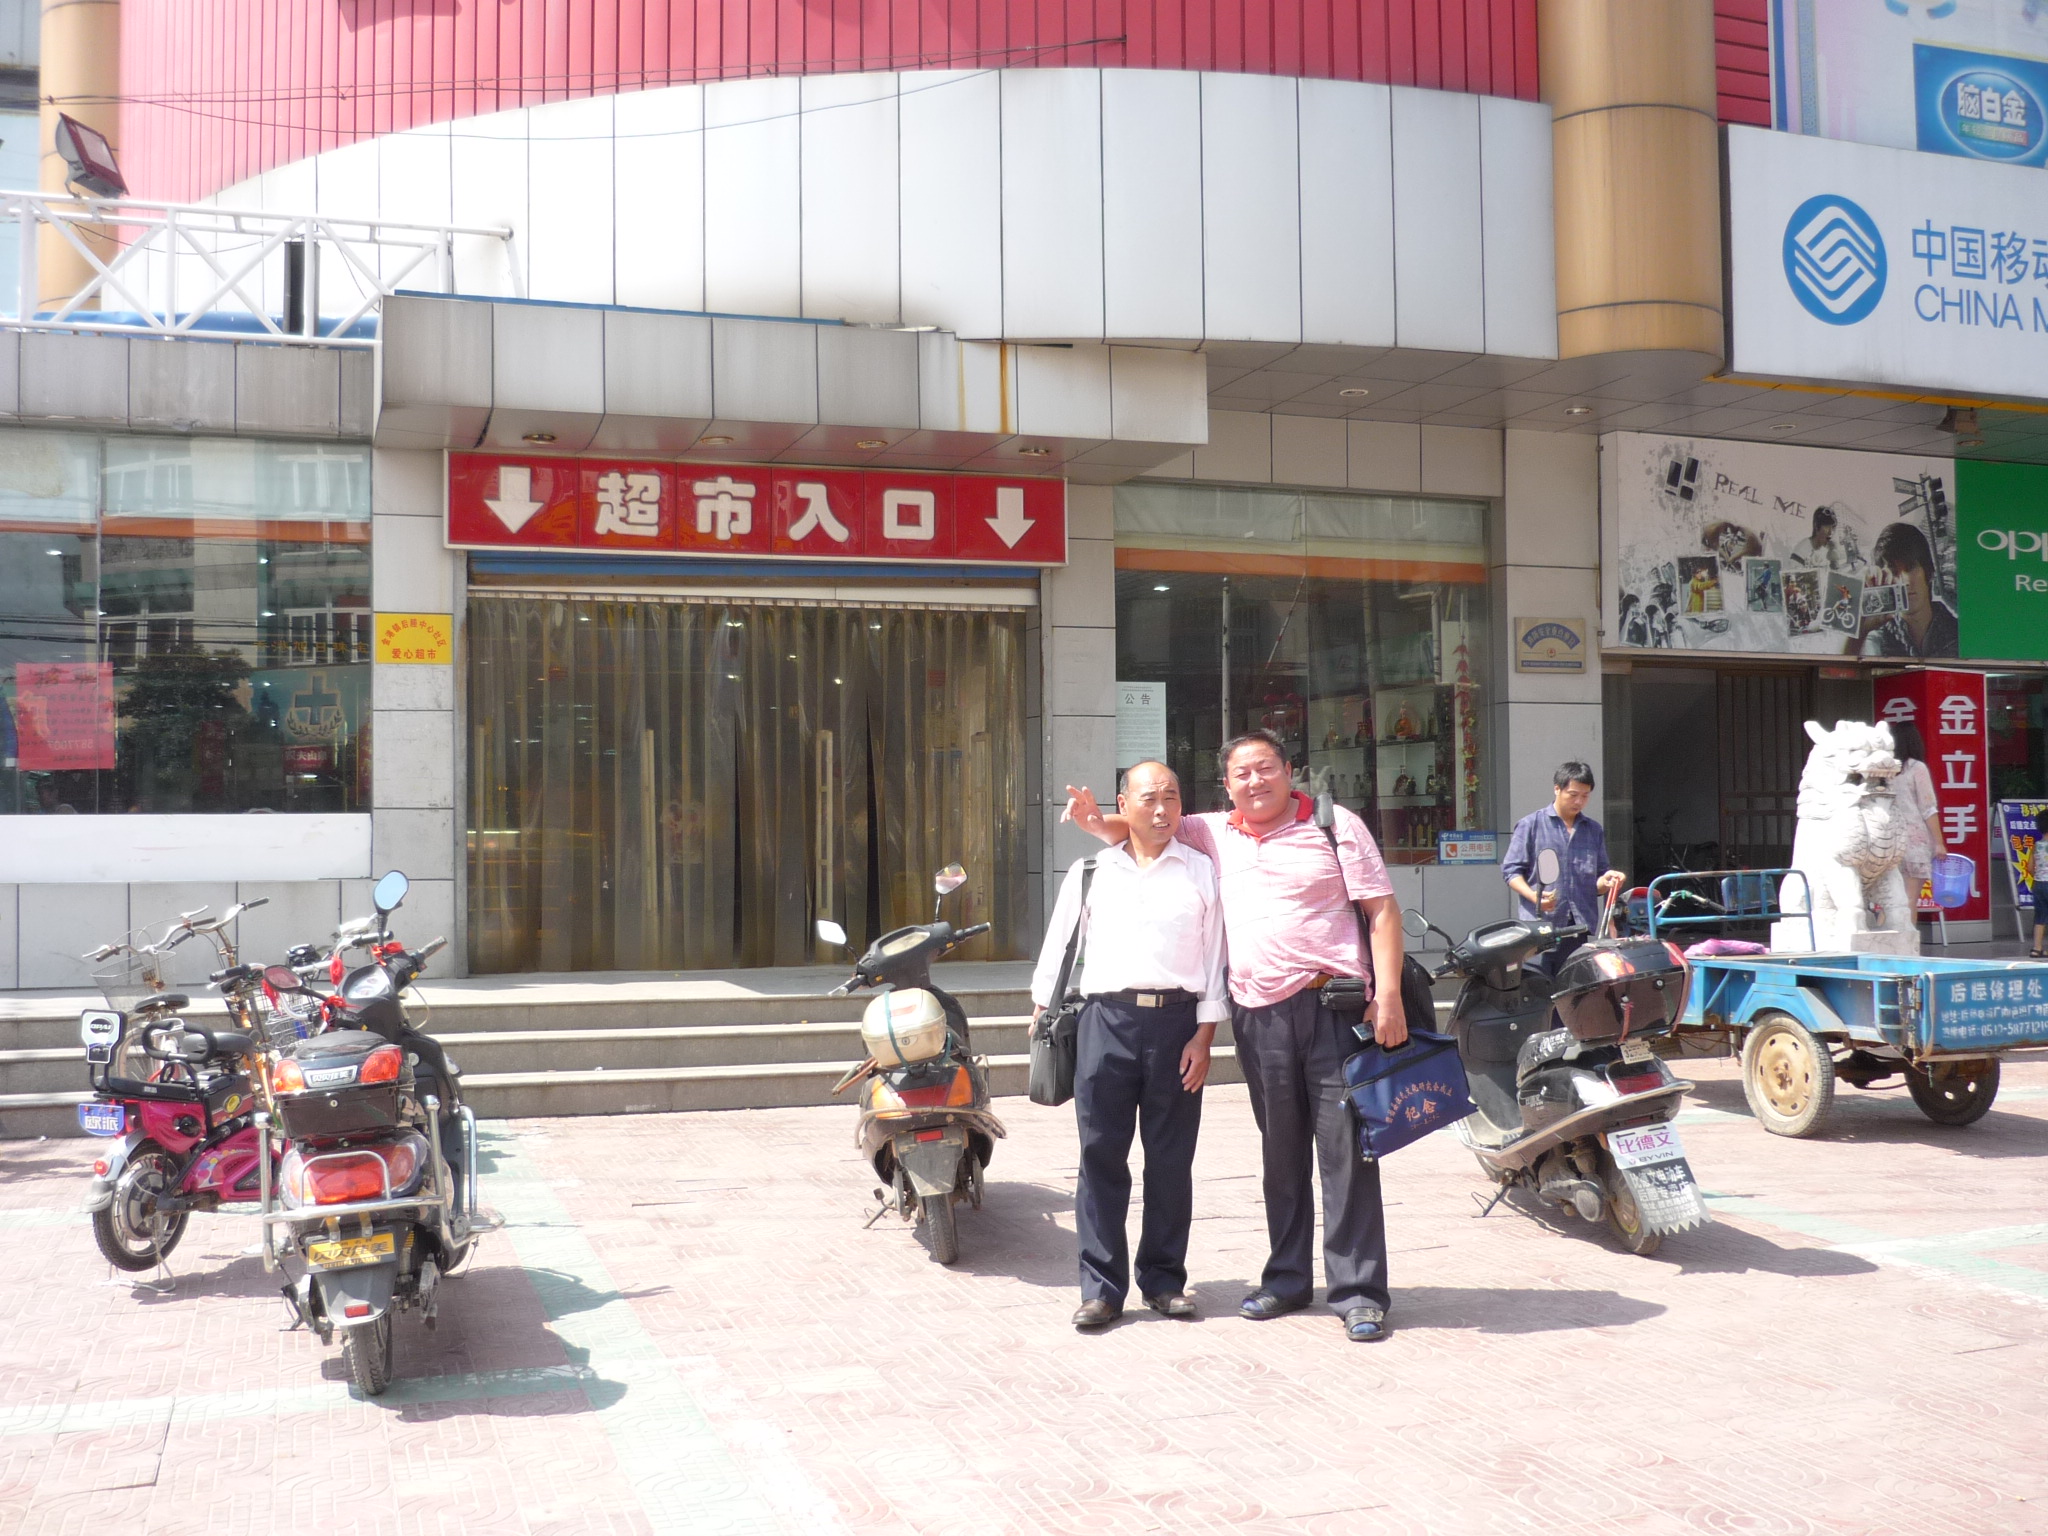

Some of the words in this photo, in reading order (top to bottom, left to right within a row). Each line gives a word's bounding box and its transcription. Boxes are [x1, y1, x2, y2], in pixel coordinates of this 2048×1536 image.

[1957, 82, 2026, 127] 脑白金
[1914, 284, 2024, 331] CHINA
[1713, 472, 1764, 506] REAL
[1772, 495, 1807, 519] ME
[595, 472, 936, 543] 超市入口
[1977, 529, 2048, 562] op
[392, 648, 437, 660] 爱心超市
[1125, 693, 1151, 704] 公告
[1938, 695, 1981, 898] 金立手
[1461, 843, 1493, 852] 公用电话
[1405, 1098, 1436, 1121] 纪念
[85, 1115, 119, 1131] 欧派
[1616, 1132, 1674, 1154] 比德文
[313, 1242, 388, 1262] 贝贝佳美
